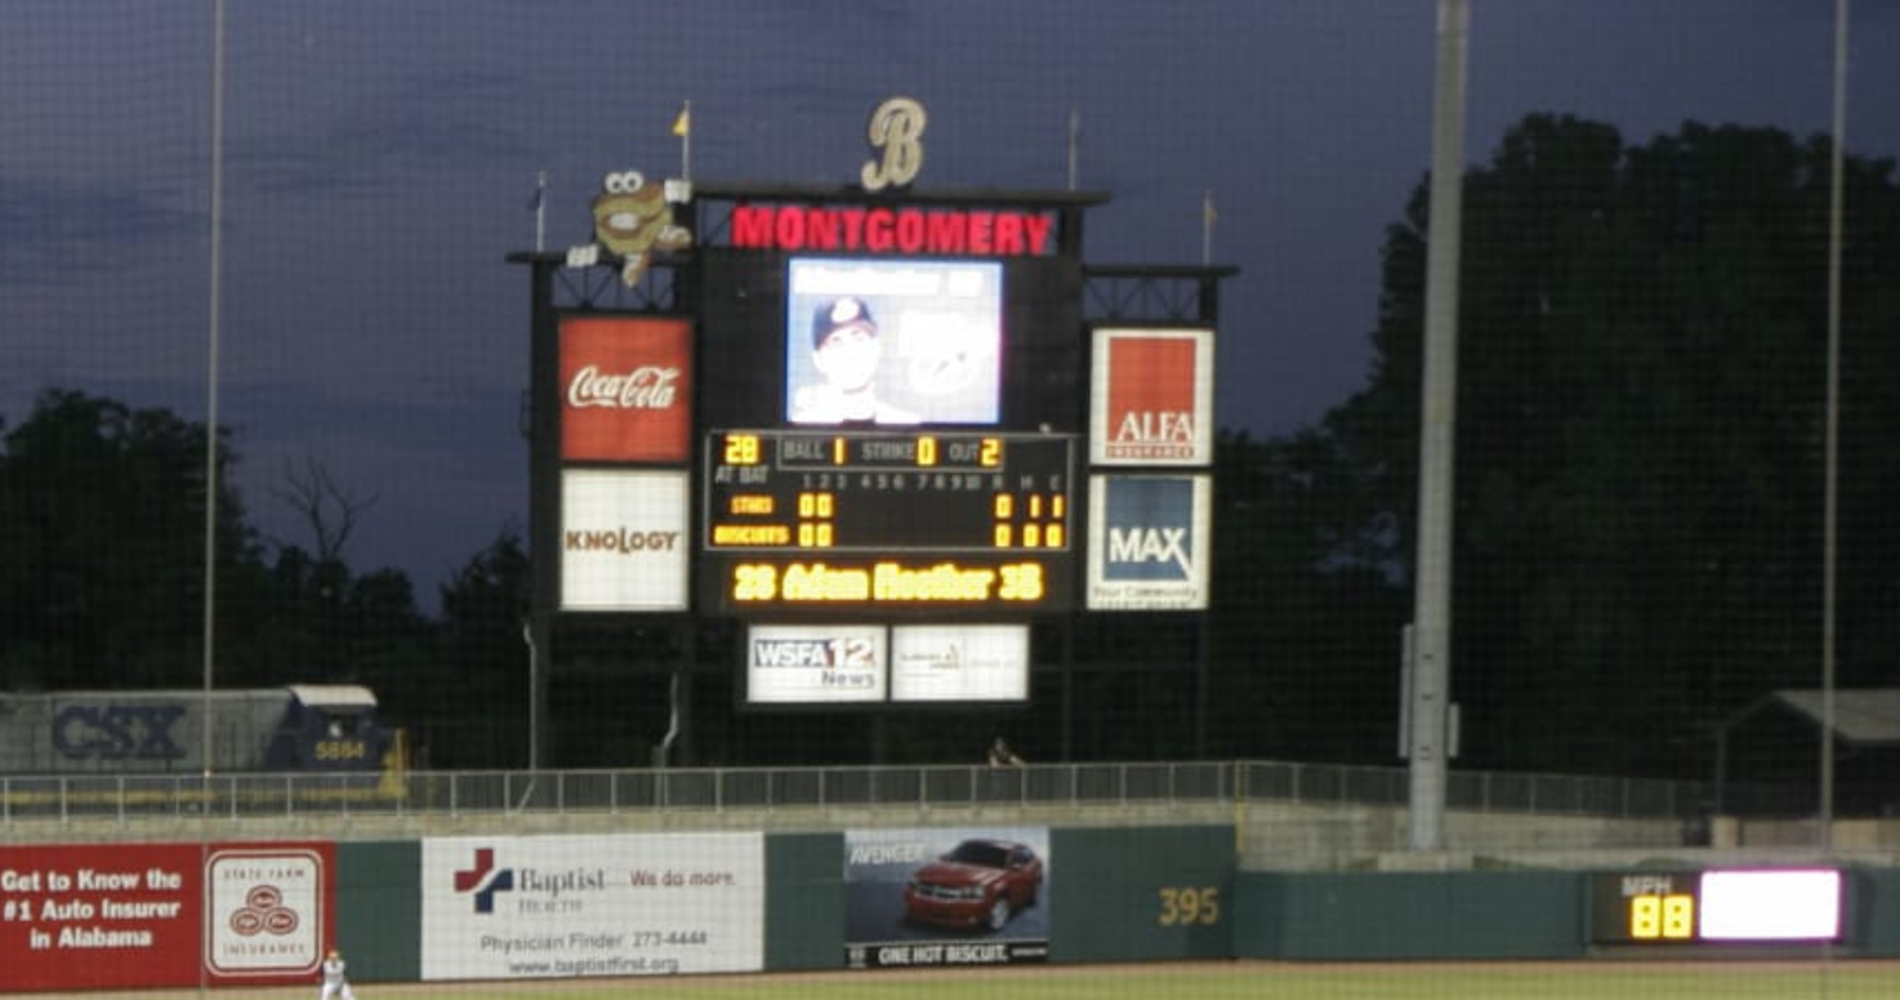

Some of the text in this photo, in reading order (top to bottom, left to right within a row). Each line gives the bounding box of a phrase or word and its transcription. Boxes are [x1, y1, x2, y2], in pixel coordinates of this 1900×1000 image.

[860, 97, 927, 191] B
[731, 204, 1053, 255] MONTGOMERY
[1116, 411, 1193, 442] ALFA
[783, 436, 1000, 466] BALL 1 STRIKE 0 OUT 2
[715, 465, 769, 483] AT BAT
[566, 527, 680, 554] KNOLOGY
[1109, 527, 1195, 579] MAX
[754, 639, 829, 667] WSFA
[822, 670, 875, 688] News
[53, 706, 187, 760] CSX
[1, 868, 182, 892] Get to Know the
[268, 867, 304, 879] FARM
[520, 867, 605, 897] Baptist
[630, 870, 660, 887] We
[662, 869, 684, 887] do
[1621, 876, 1672, 897] MPH
[3, 898, 181, 922] #1 Auto Insurer
[1158, 886, 1218, 925] 395
[1631, 895, 1693, 939] 88
[30, 927, 153, 949] in Alabama
[481, 935, 564, 955] Physician
[569, 932, 623, 950] Finder
[878, 946, 910, 965] ONE
[913, 946, 942, 964] HOT
